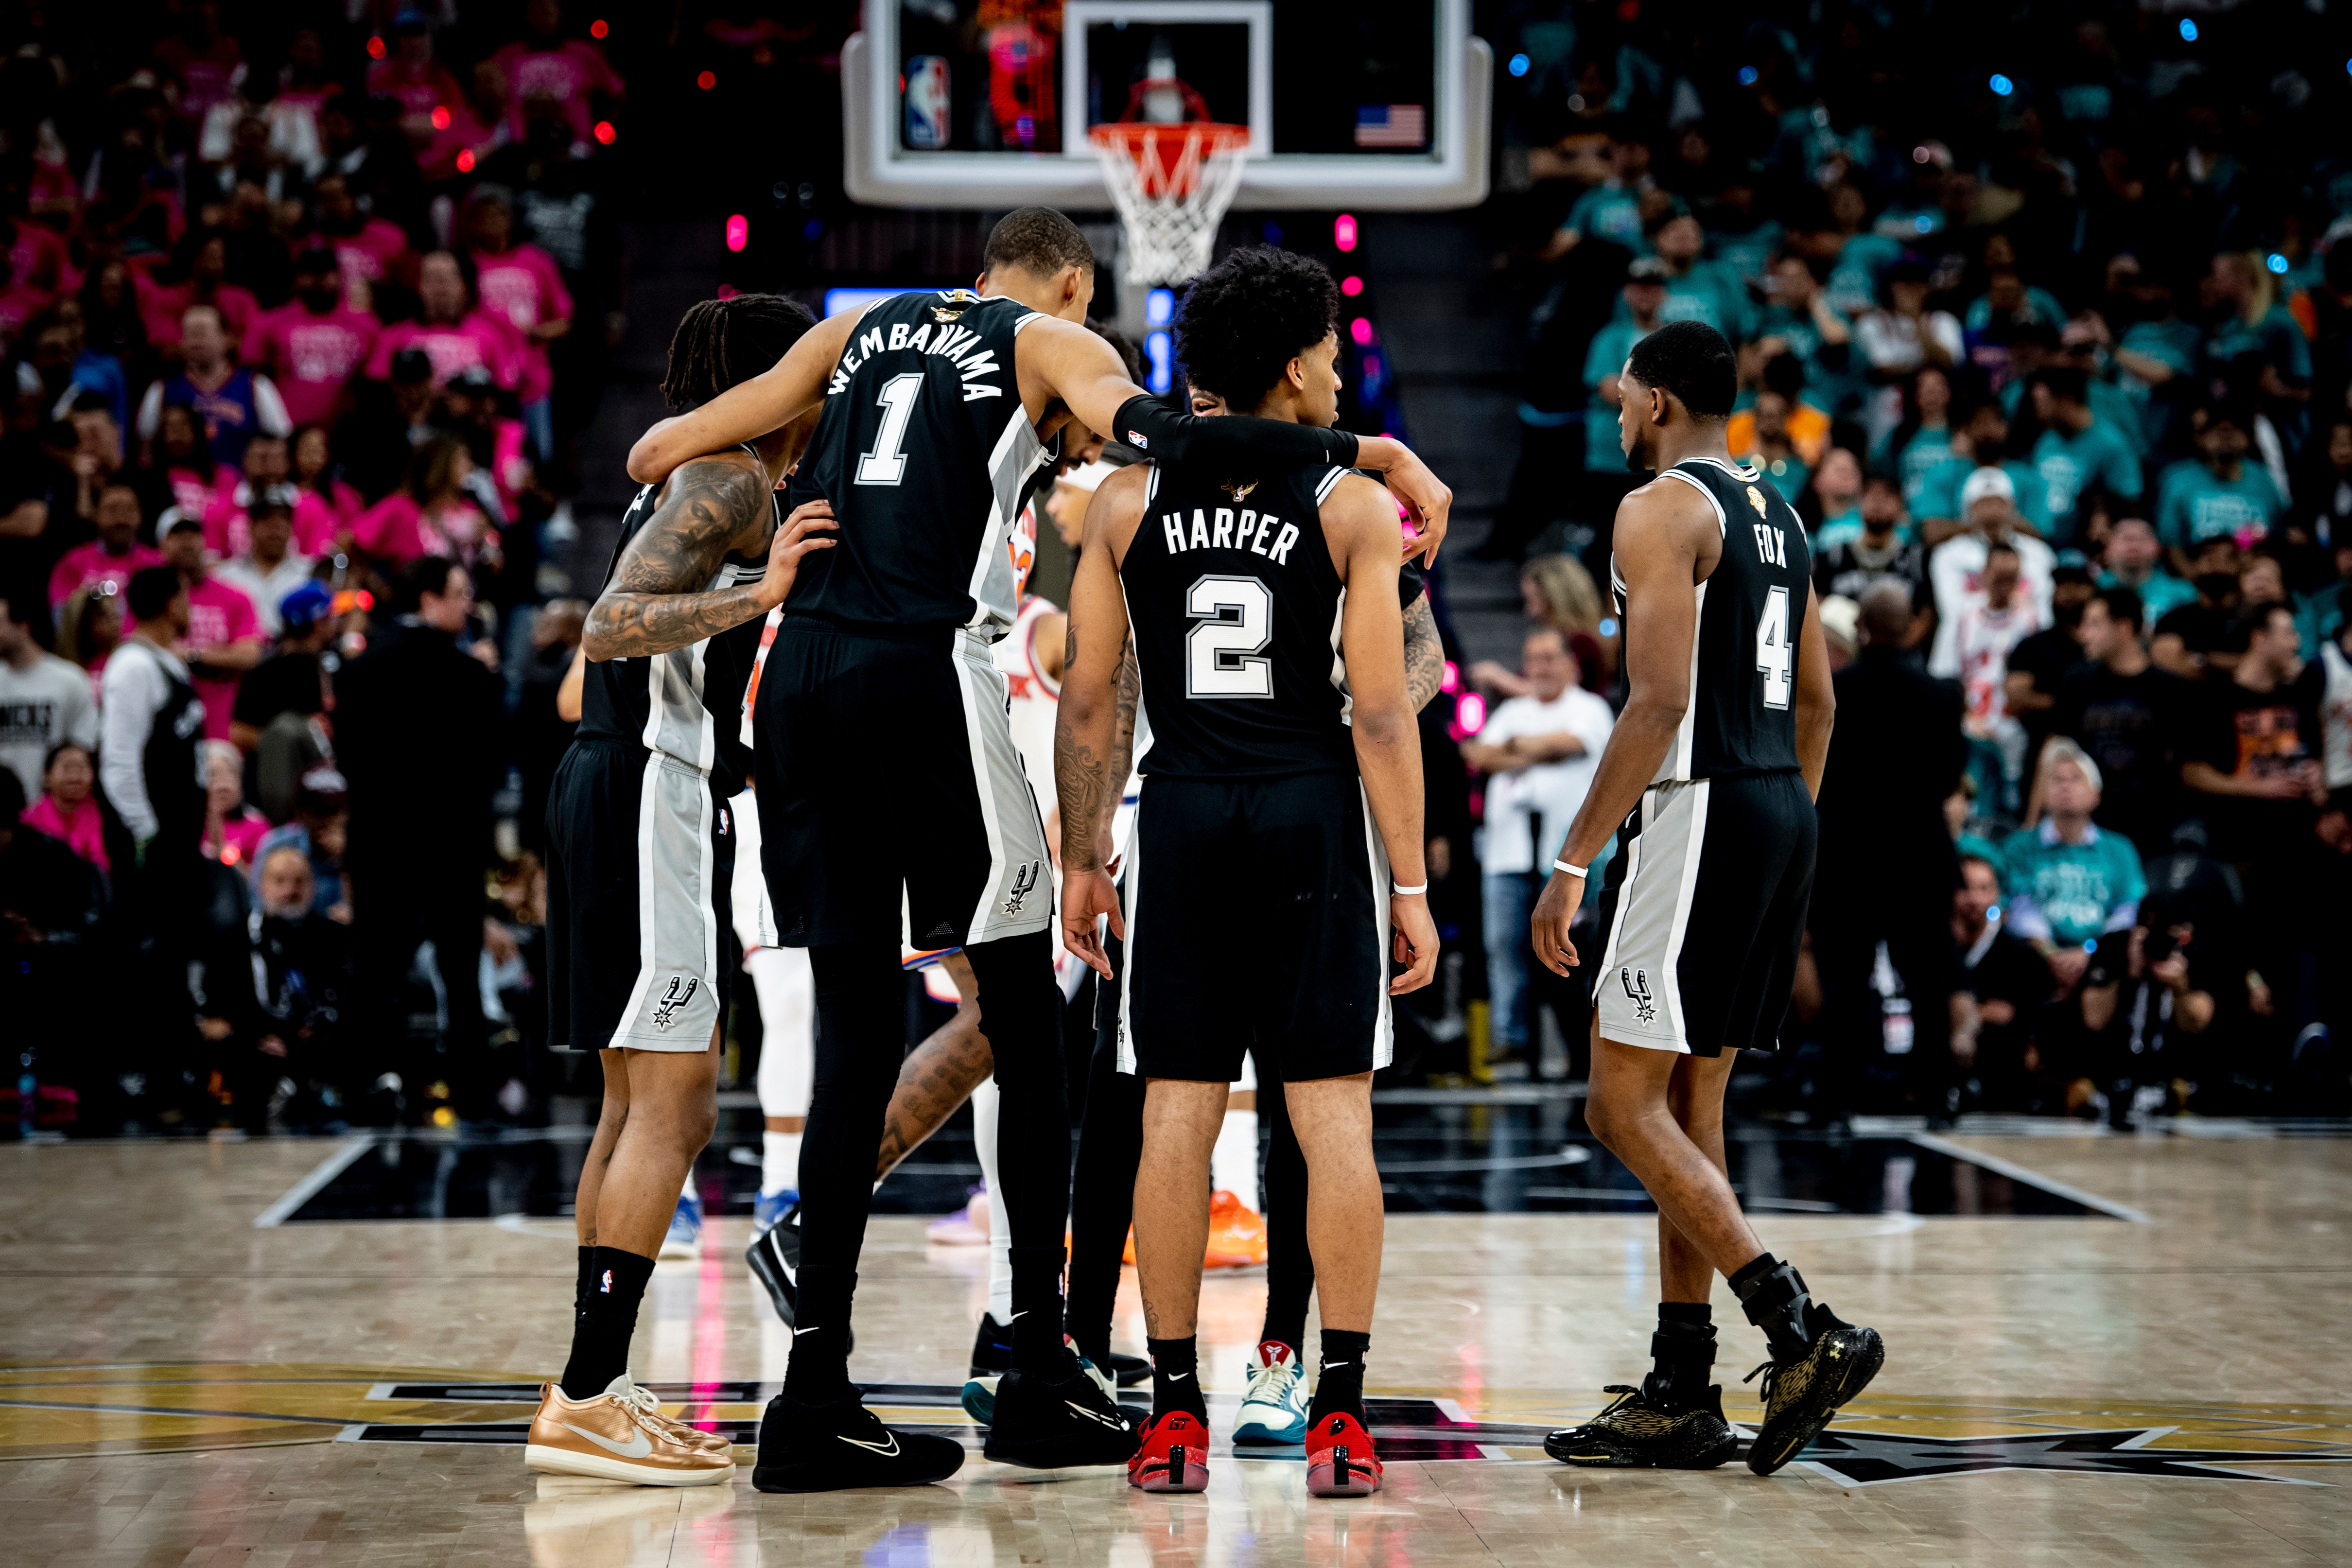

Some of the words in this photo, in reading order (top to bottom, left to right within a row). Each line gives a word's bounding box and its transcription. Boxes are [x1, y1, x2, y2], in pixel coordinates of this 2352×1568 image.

[828, 324, 1001, 401] WEMBANYAMA
[854, 373, 924, 486] 1
[1163, 508, 1299, 565] HARPER
[1753, 524, 1787, 568] FOX
[1186, 574, 1274, 699] 2
[1757, 585, 1793, 710] 4
[1169, 1418, 1190, 1430] GT
